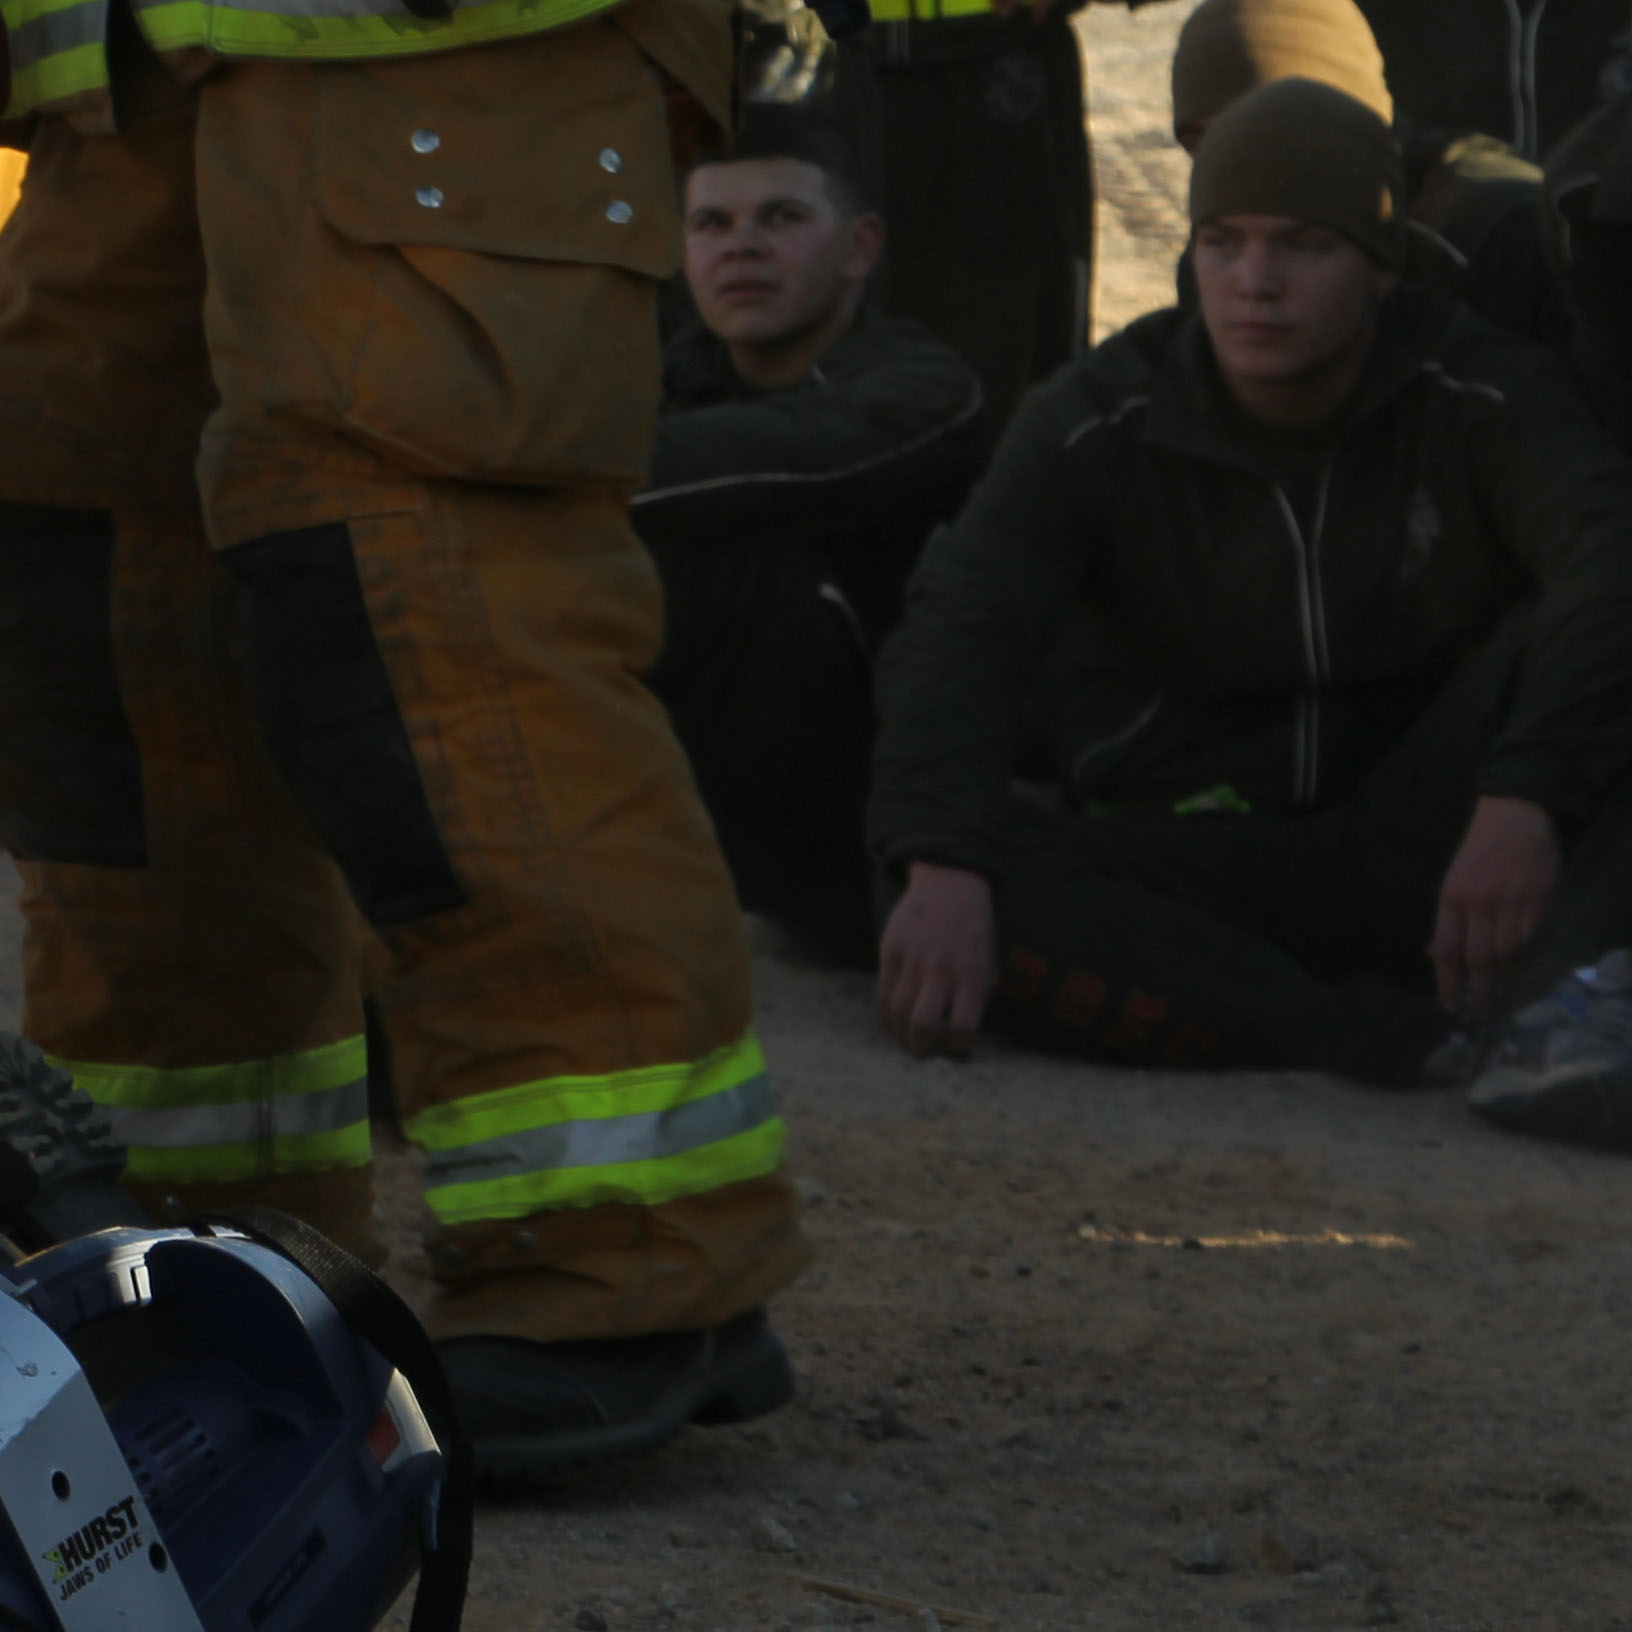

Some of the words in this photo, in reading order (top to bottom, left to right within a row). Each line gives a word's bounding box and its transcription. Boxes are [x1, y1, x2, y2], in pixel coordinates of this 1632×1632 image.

[58, 1495, 139, 1572] HURST
[60, 1566, 94, 1601] JAWS
[95, 1552, 112, 1574] OF
[114, 1532, 144, 1560] LIFE
